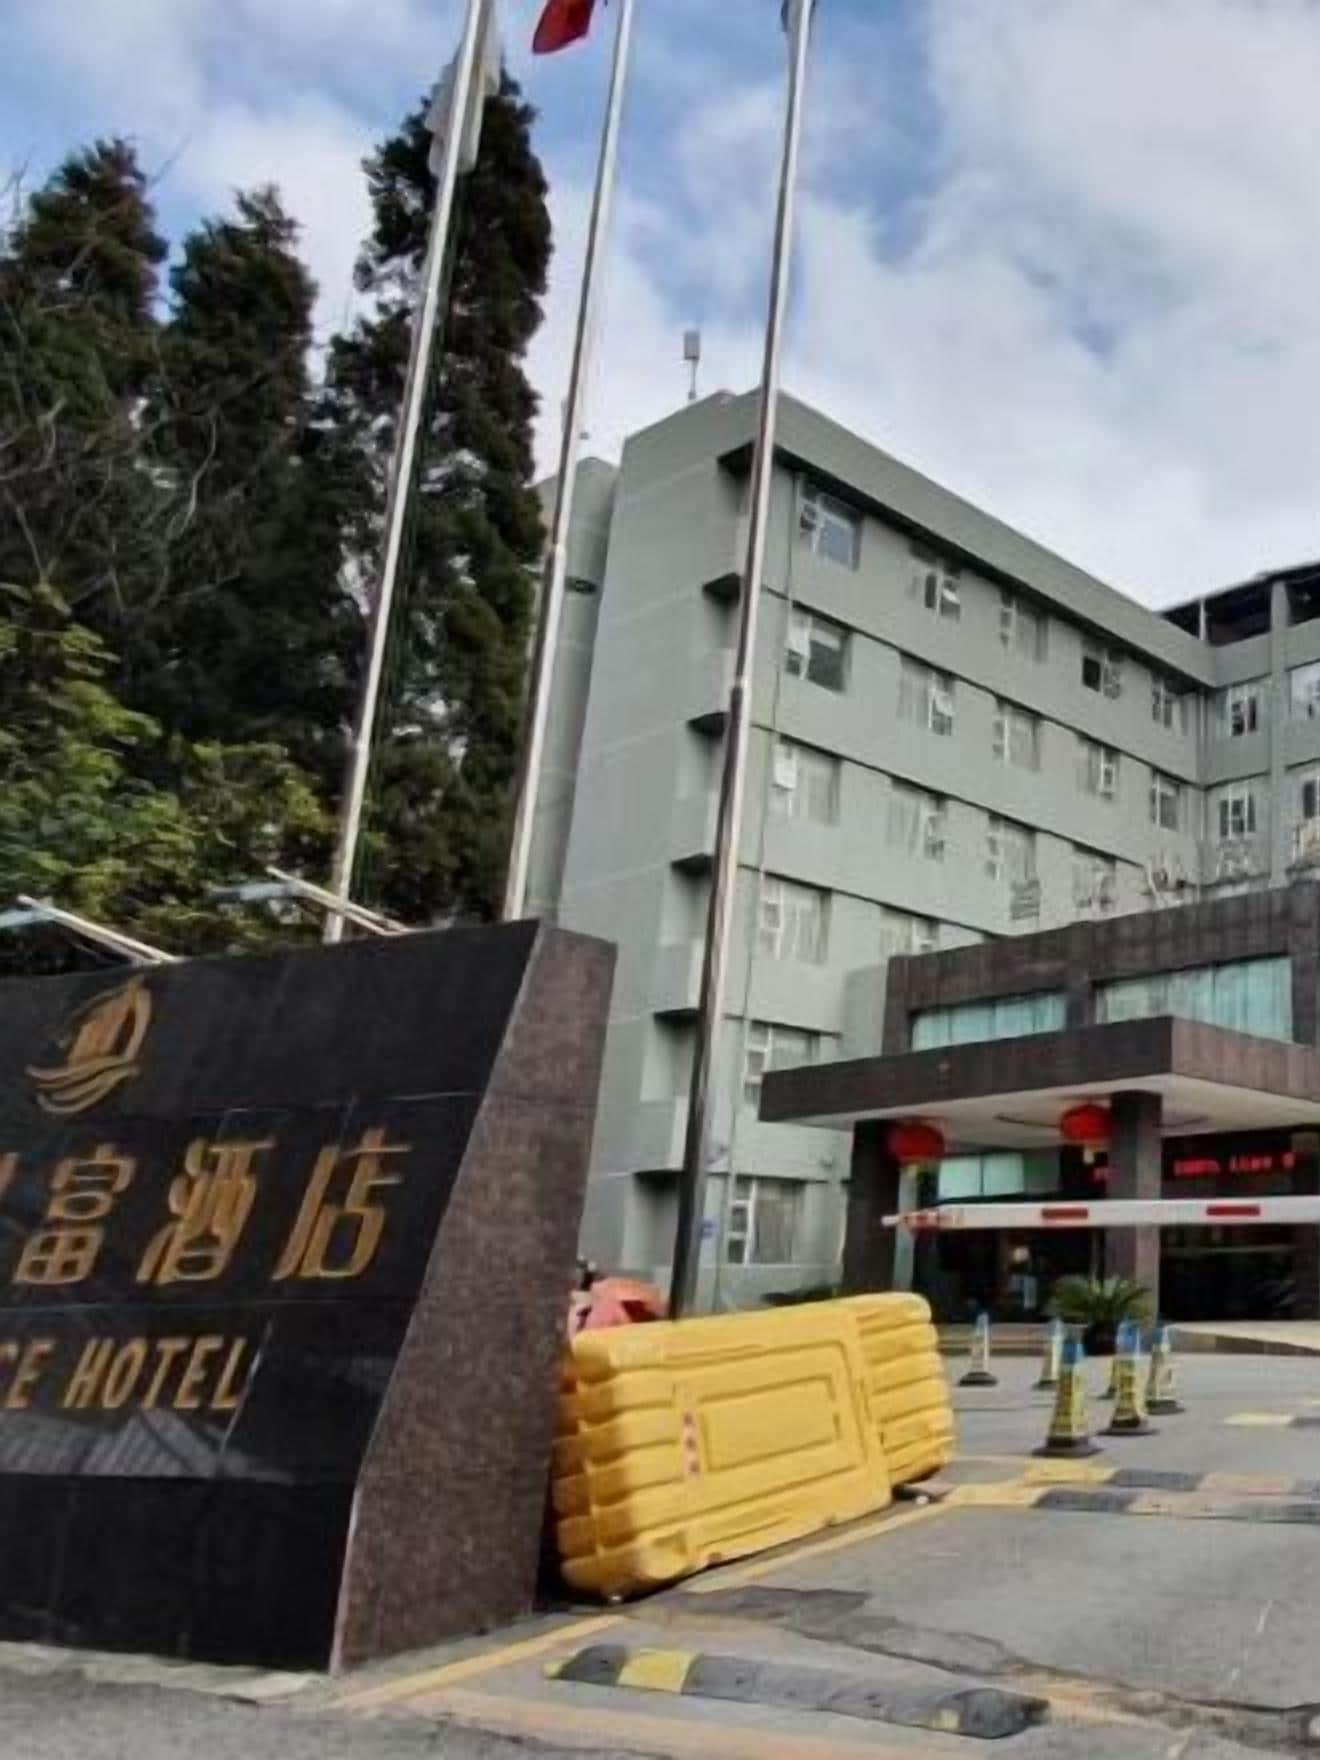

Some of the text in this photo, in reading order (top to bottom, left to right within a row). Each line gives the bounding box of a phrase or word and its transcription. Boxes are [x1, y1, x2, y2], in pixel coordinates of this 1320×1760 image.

[0, 1127, 411, 1285] 富酒店
[63, 1335, 252, 1410] HOTEL
